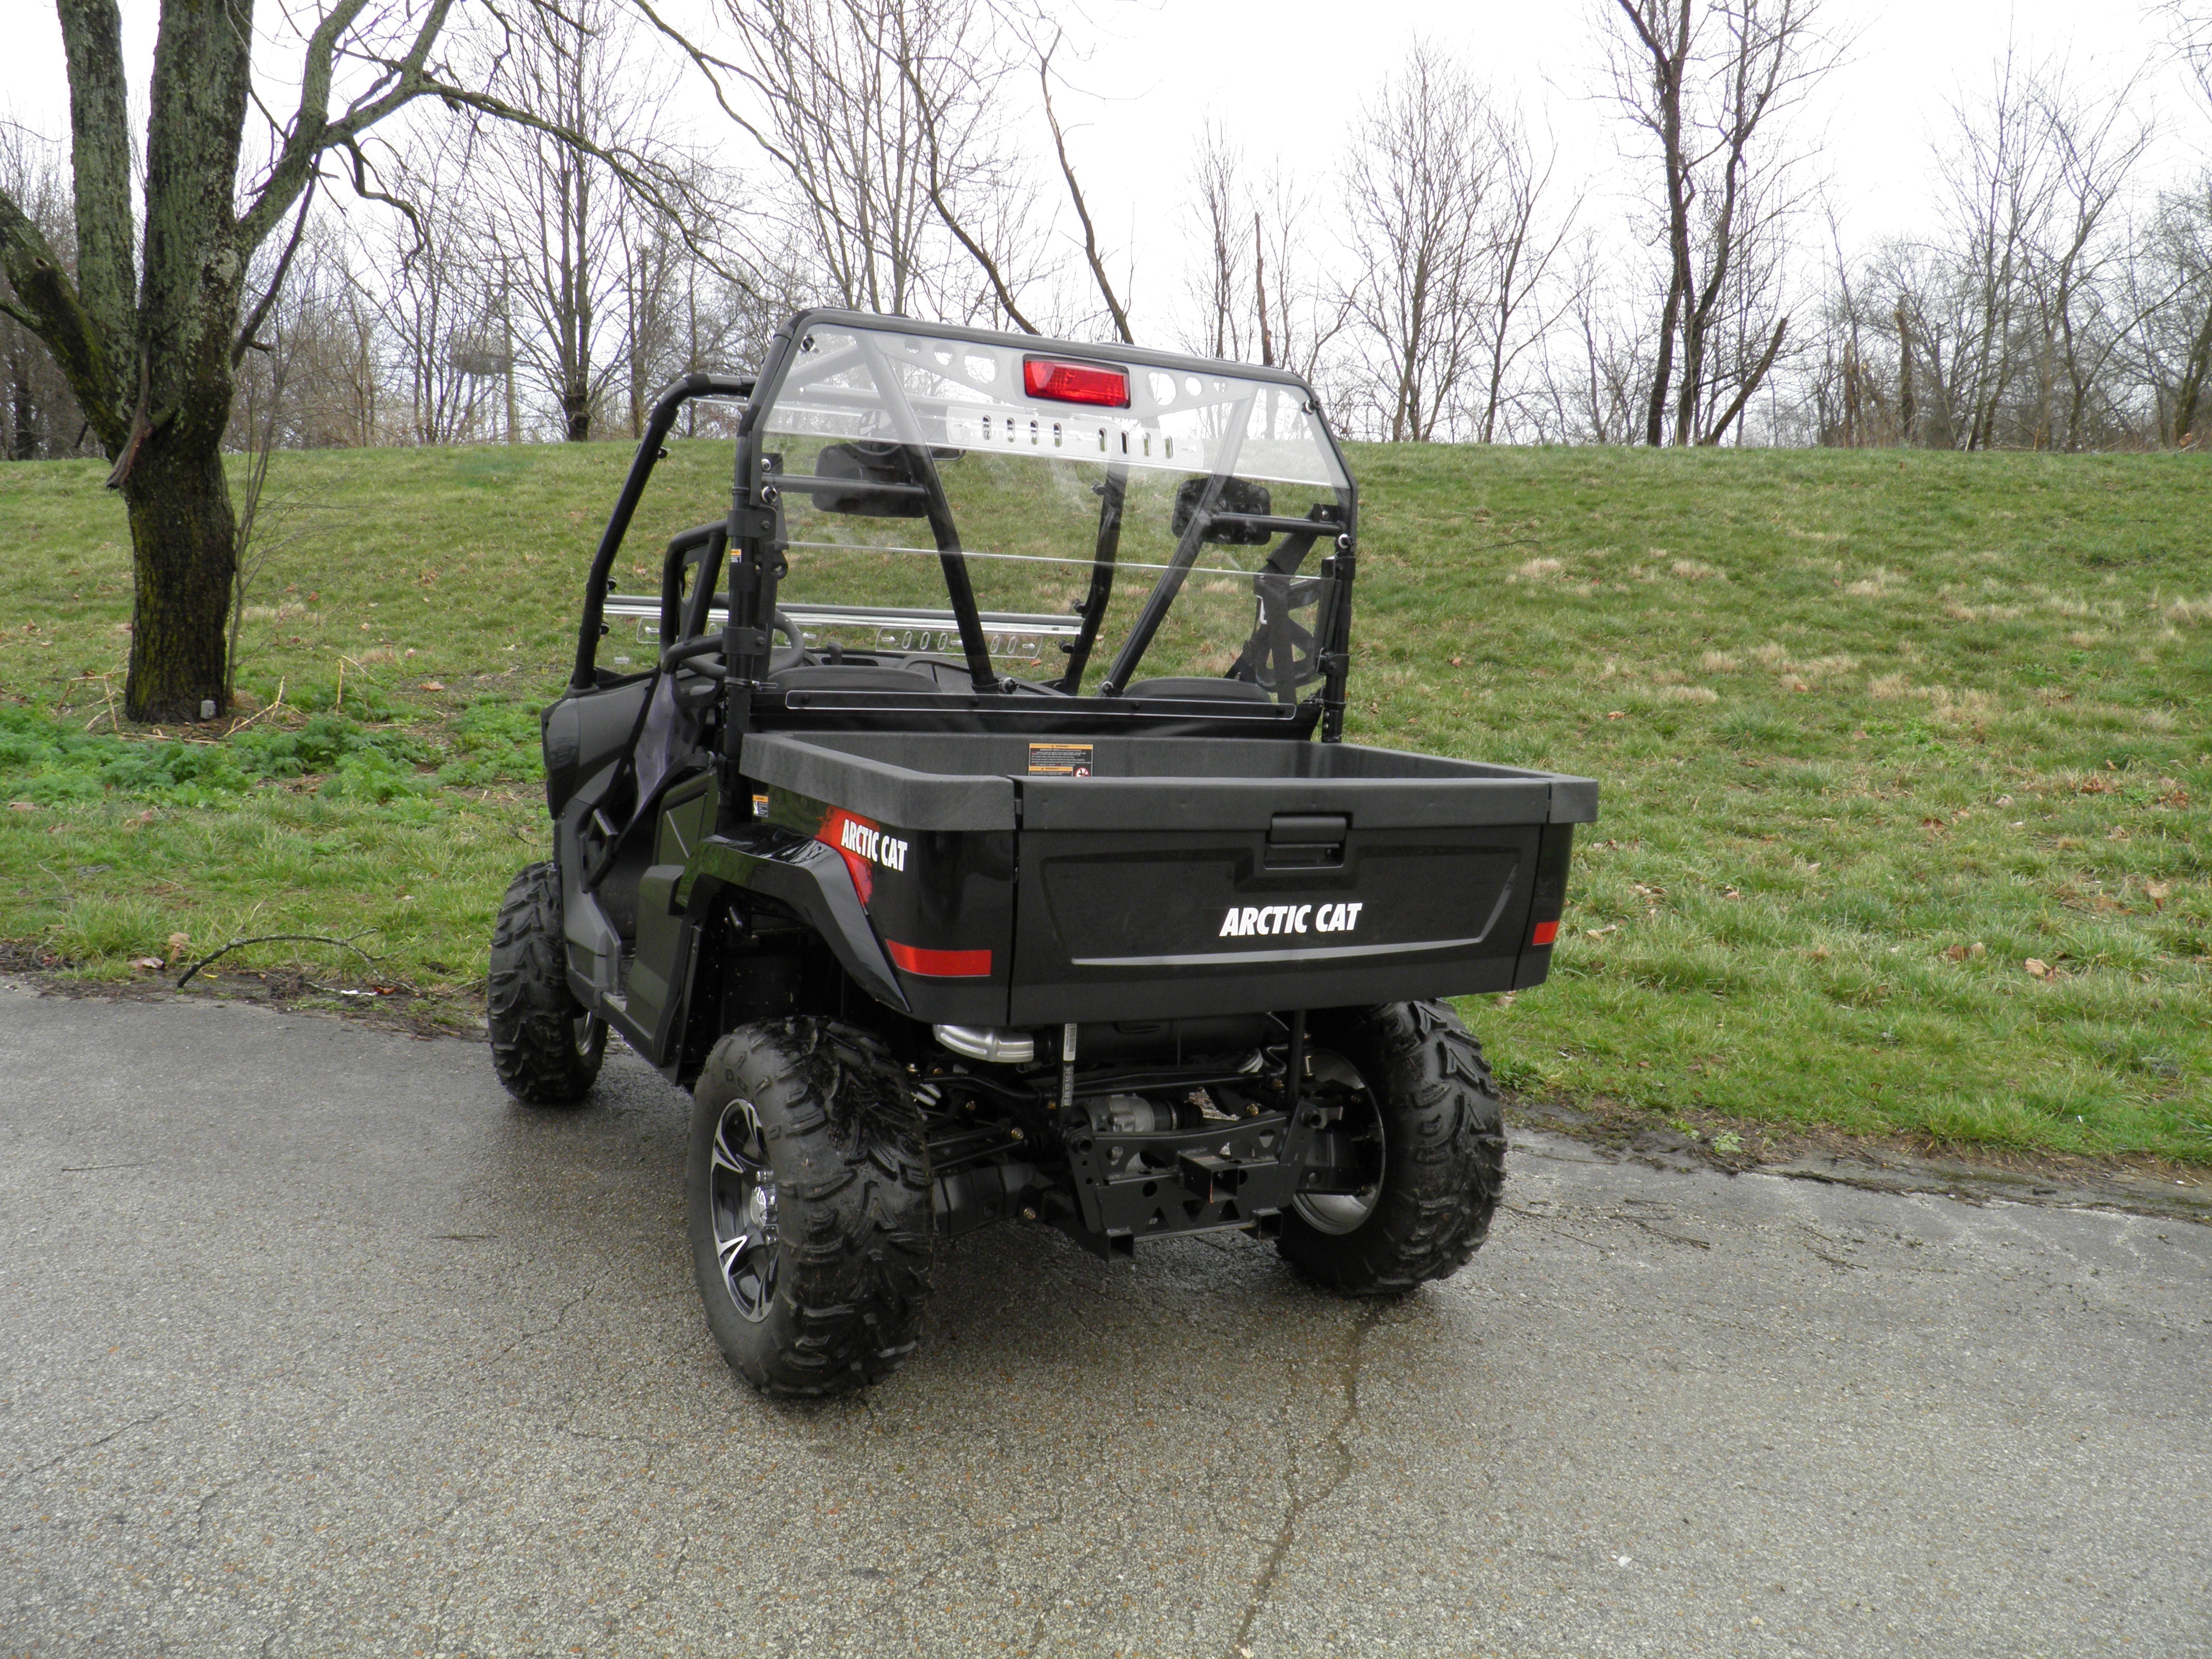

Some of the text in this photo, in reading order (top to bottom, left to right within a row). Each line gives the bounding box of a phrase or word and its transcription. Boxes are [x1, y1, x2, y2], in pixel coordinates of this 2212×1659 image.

[841, 819, 908, 872] ARCTIC CAT
[1219, 903, 1363, 936] ARCTIC CAT
